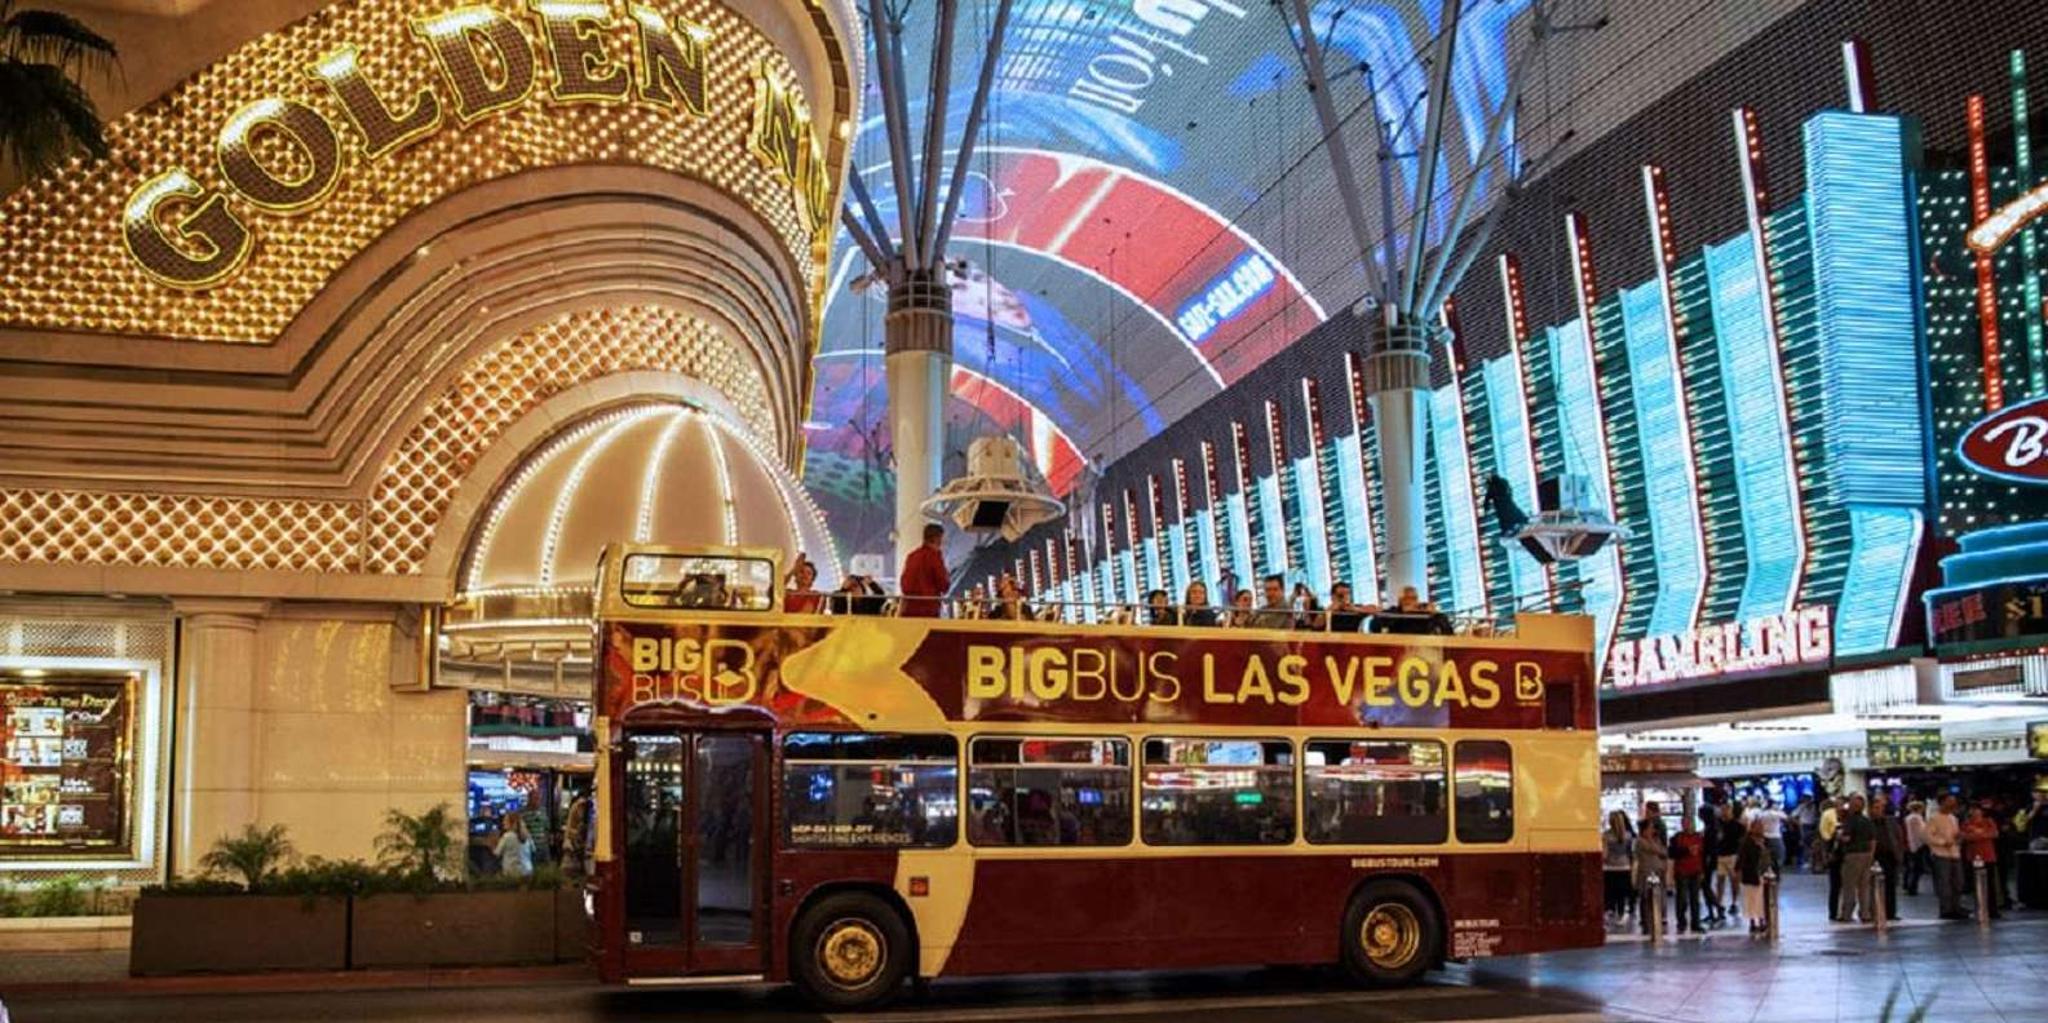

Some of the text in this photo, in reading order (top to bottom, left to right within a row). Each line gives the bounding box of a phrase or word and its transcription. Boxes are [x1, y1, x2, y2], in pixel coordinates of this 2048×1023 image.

[123, 0, 712, 289] GOLDEN
[1984, 416, 2048, 467] B
[633, 637, 701, 672] BIG
[1613, 605, 1829, 687] GAMBLING
[633, 673, 701, 704] BUS
[1203, 653, 1310, 706] LAS
[1325, 656, 1500, 709] VEGAS
